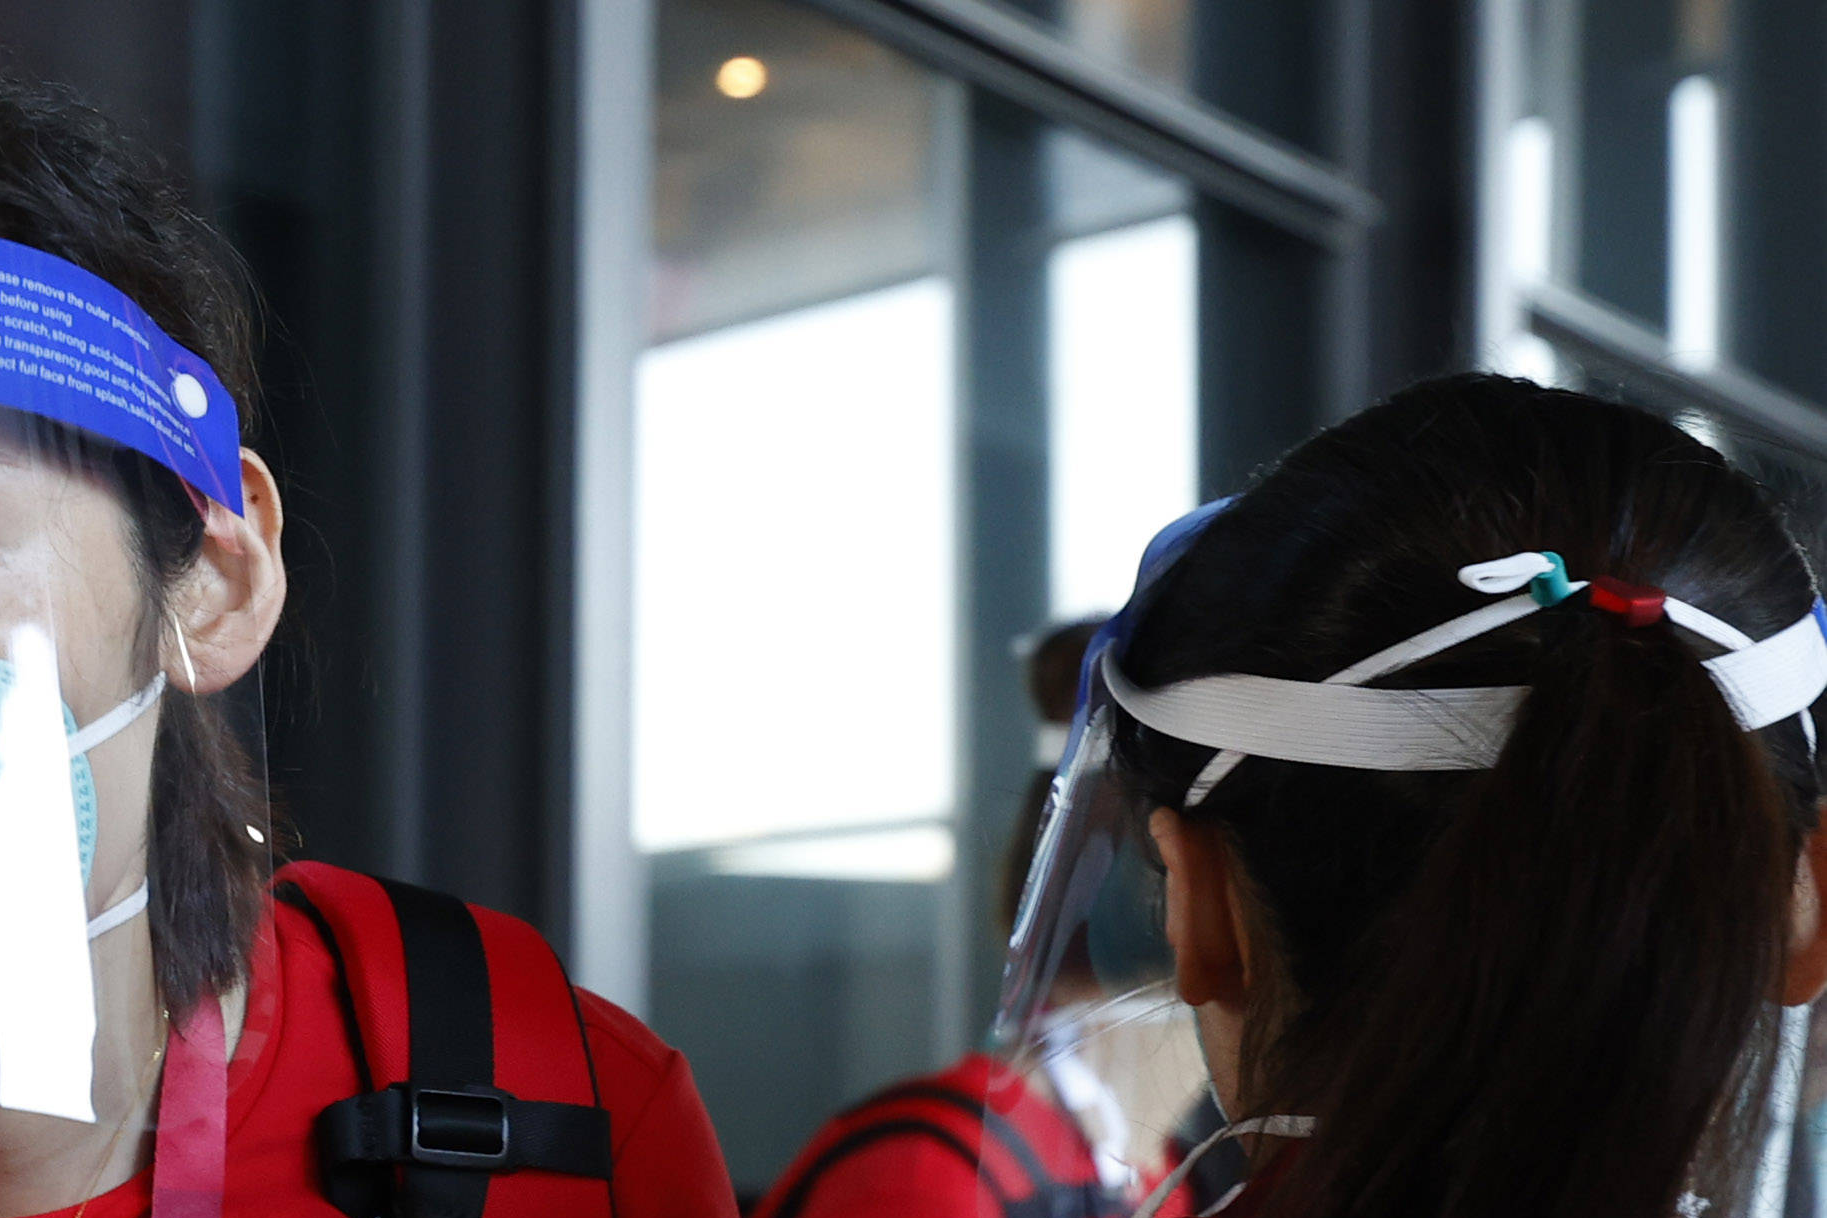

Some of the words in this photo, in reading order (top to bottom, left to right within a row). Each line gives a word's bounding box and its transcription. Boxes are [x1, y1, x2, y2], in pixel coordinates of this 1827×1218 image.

[0, 290, 39, 314] before
[42, 305, 73, 328] using
[22, 278, 66, 302] remove
[67, 292, 84, 310] the
[19, 359, 38, 376] full
[40, 364, 66, 385] face
[67, 374, 93, 396] from
